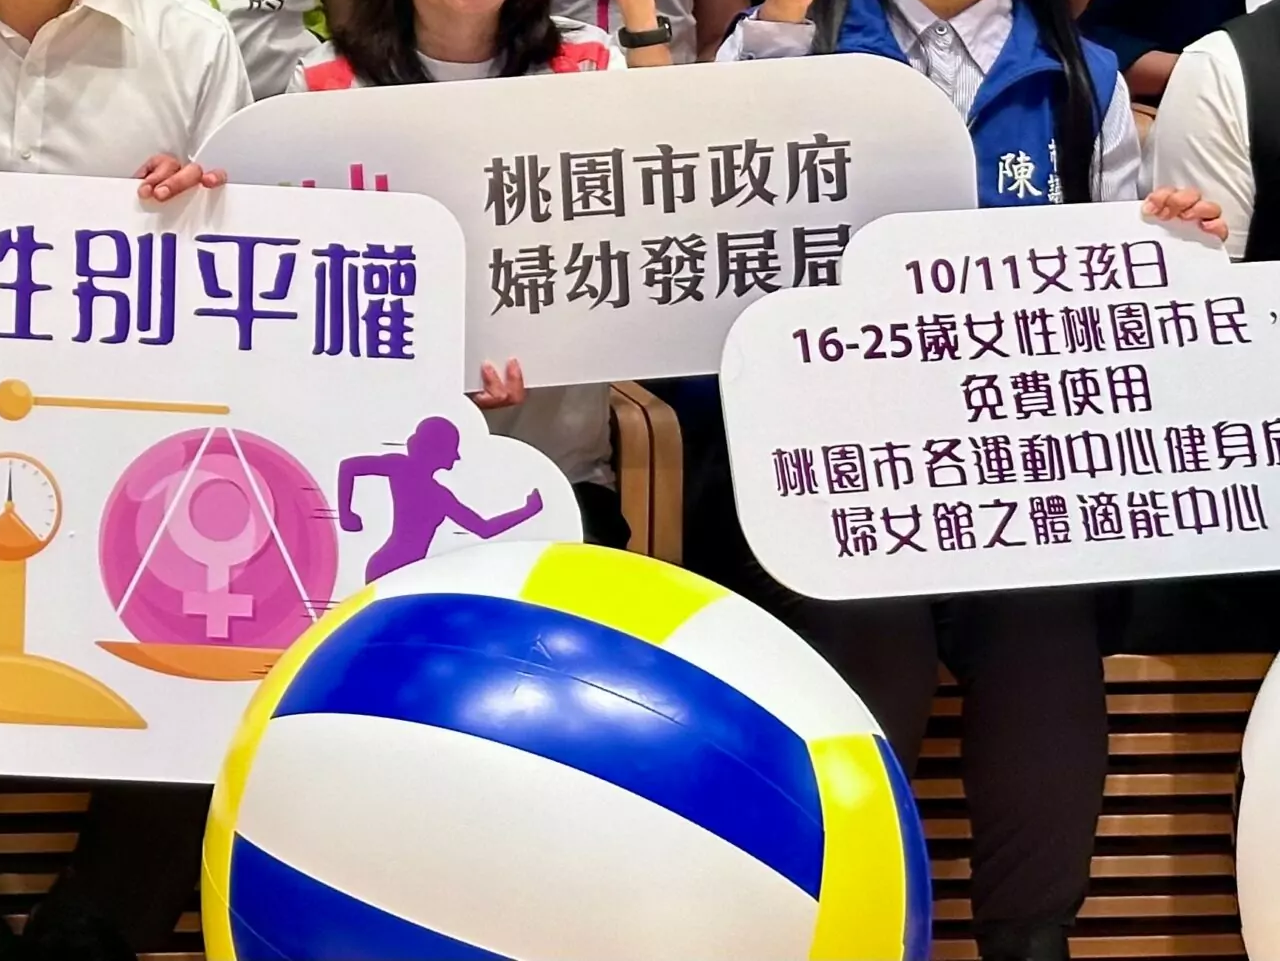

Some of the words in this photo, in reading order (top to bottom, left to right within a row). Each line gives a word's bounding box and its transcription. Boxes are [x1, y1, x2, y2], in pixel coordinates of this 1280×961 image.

[483, 133, 853, 227] 桃園市政府
[998, 150, 1043, 199] 陳
[489, 224, 852, 317] 婦幼發展局
[905, 240, 1169, 295] 10/11女孩日
[961, 364, 1153, 423] 免費使用
[831, 482, 1269, 559] 婦女館之體適能中心
